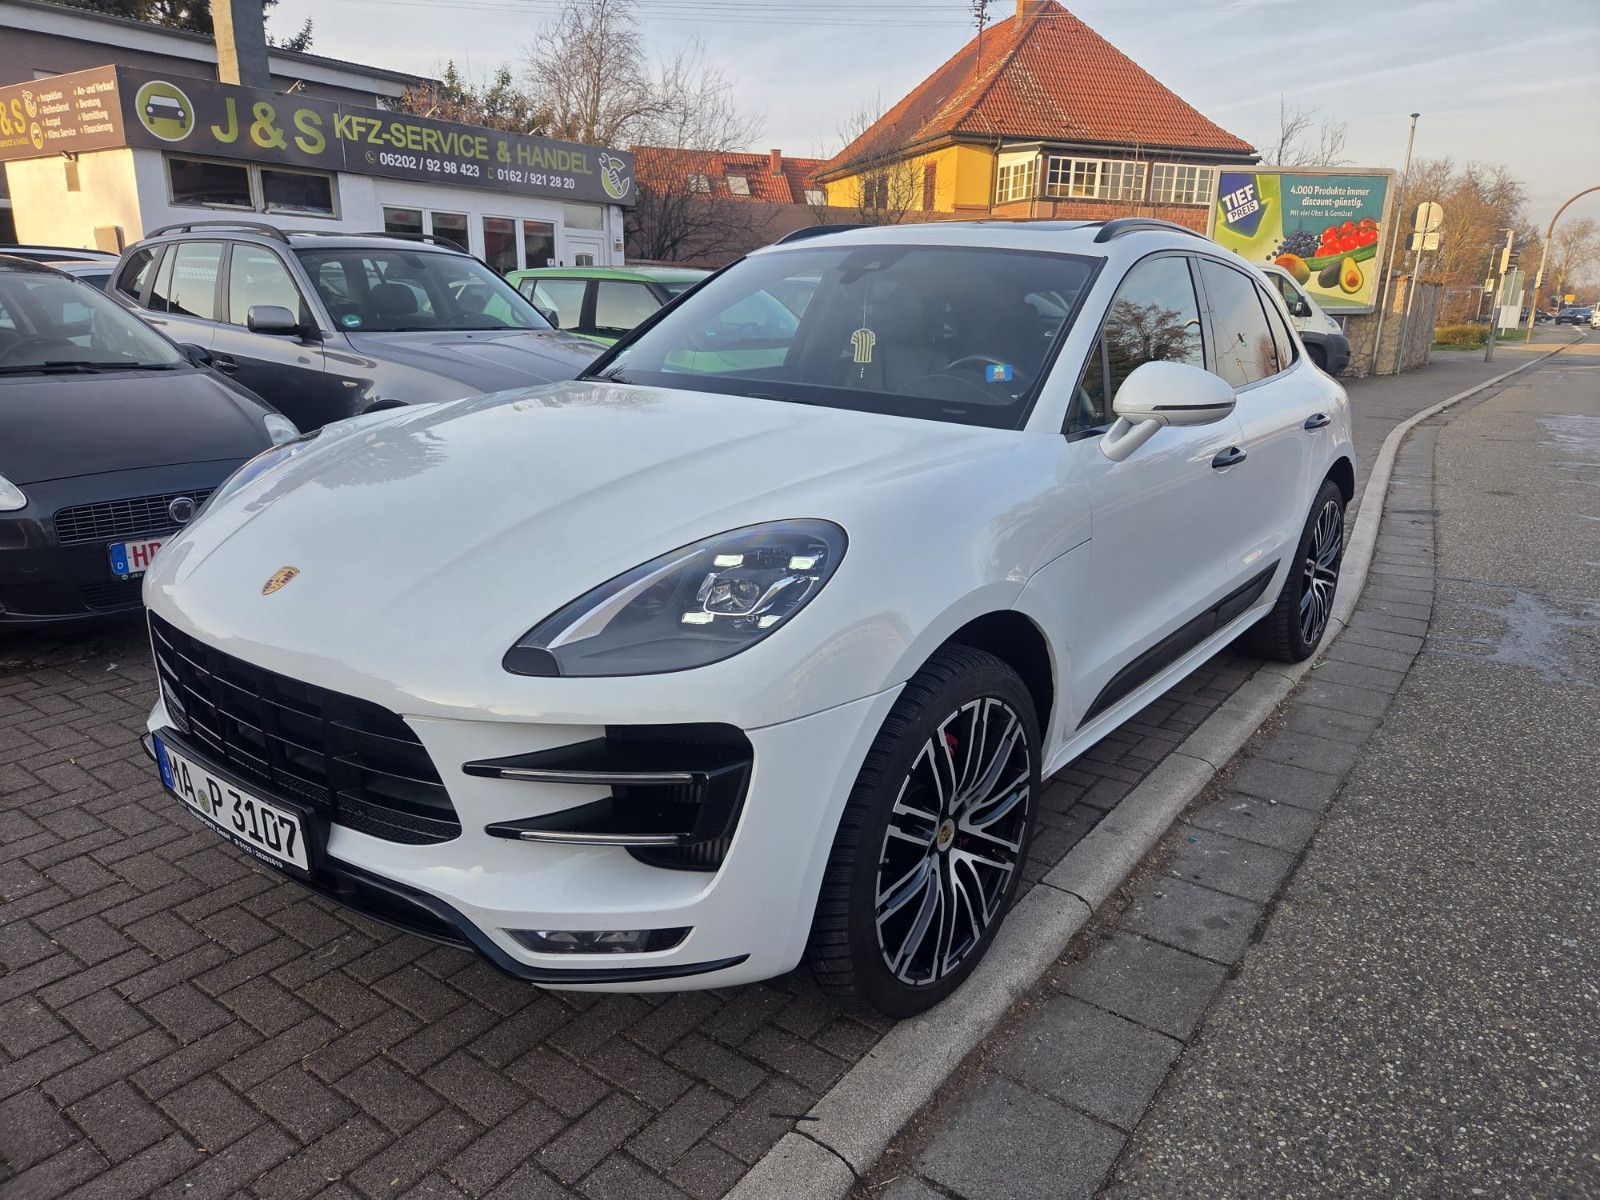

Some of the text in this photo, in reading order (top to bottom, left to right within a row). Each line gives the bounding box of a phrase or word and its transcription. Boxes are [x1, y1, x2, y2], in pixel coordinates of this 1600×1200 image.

[333, 112, 593, 175] KFZ-SERVICE & HANDEL
[380, 152, 417, 170] 06202
[426, 157, 441, 172] 92
[443, 160, 457, 174] 98
[460, 163, 480, 177] 423
[497, 168, 522, 183] 0162
[530, 172, 547, 186] 921
[549, 176, 562, 188] 28
[563, 177, 575, 190] 20
[1222, 183, 1254, 211] TIEF
[1290, 185, 1370, 196] 4.000 Produkte immer
[1230, 202, 1256, 220] PREIS
[1302, 197, 1363, 208] discount-günstig.
[117, 562, 124, 570] D
[206, 776, 223, 817] P
[228, 789, 296, 858] 3107
